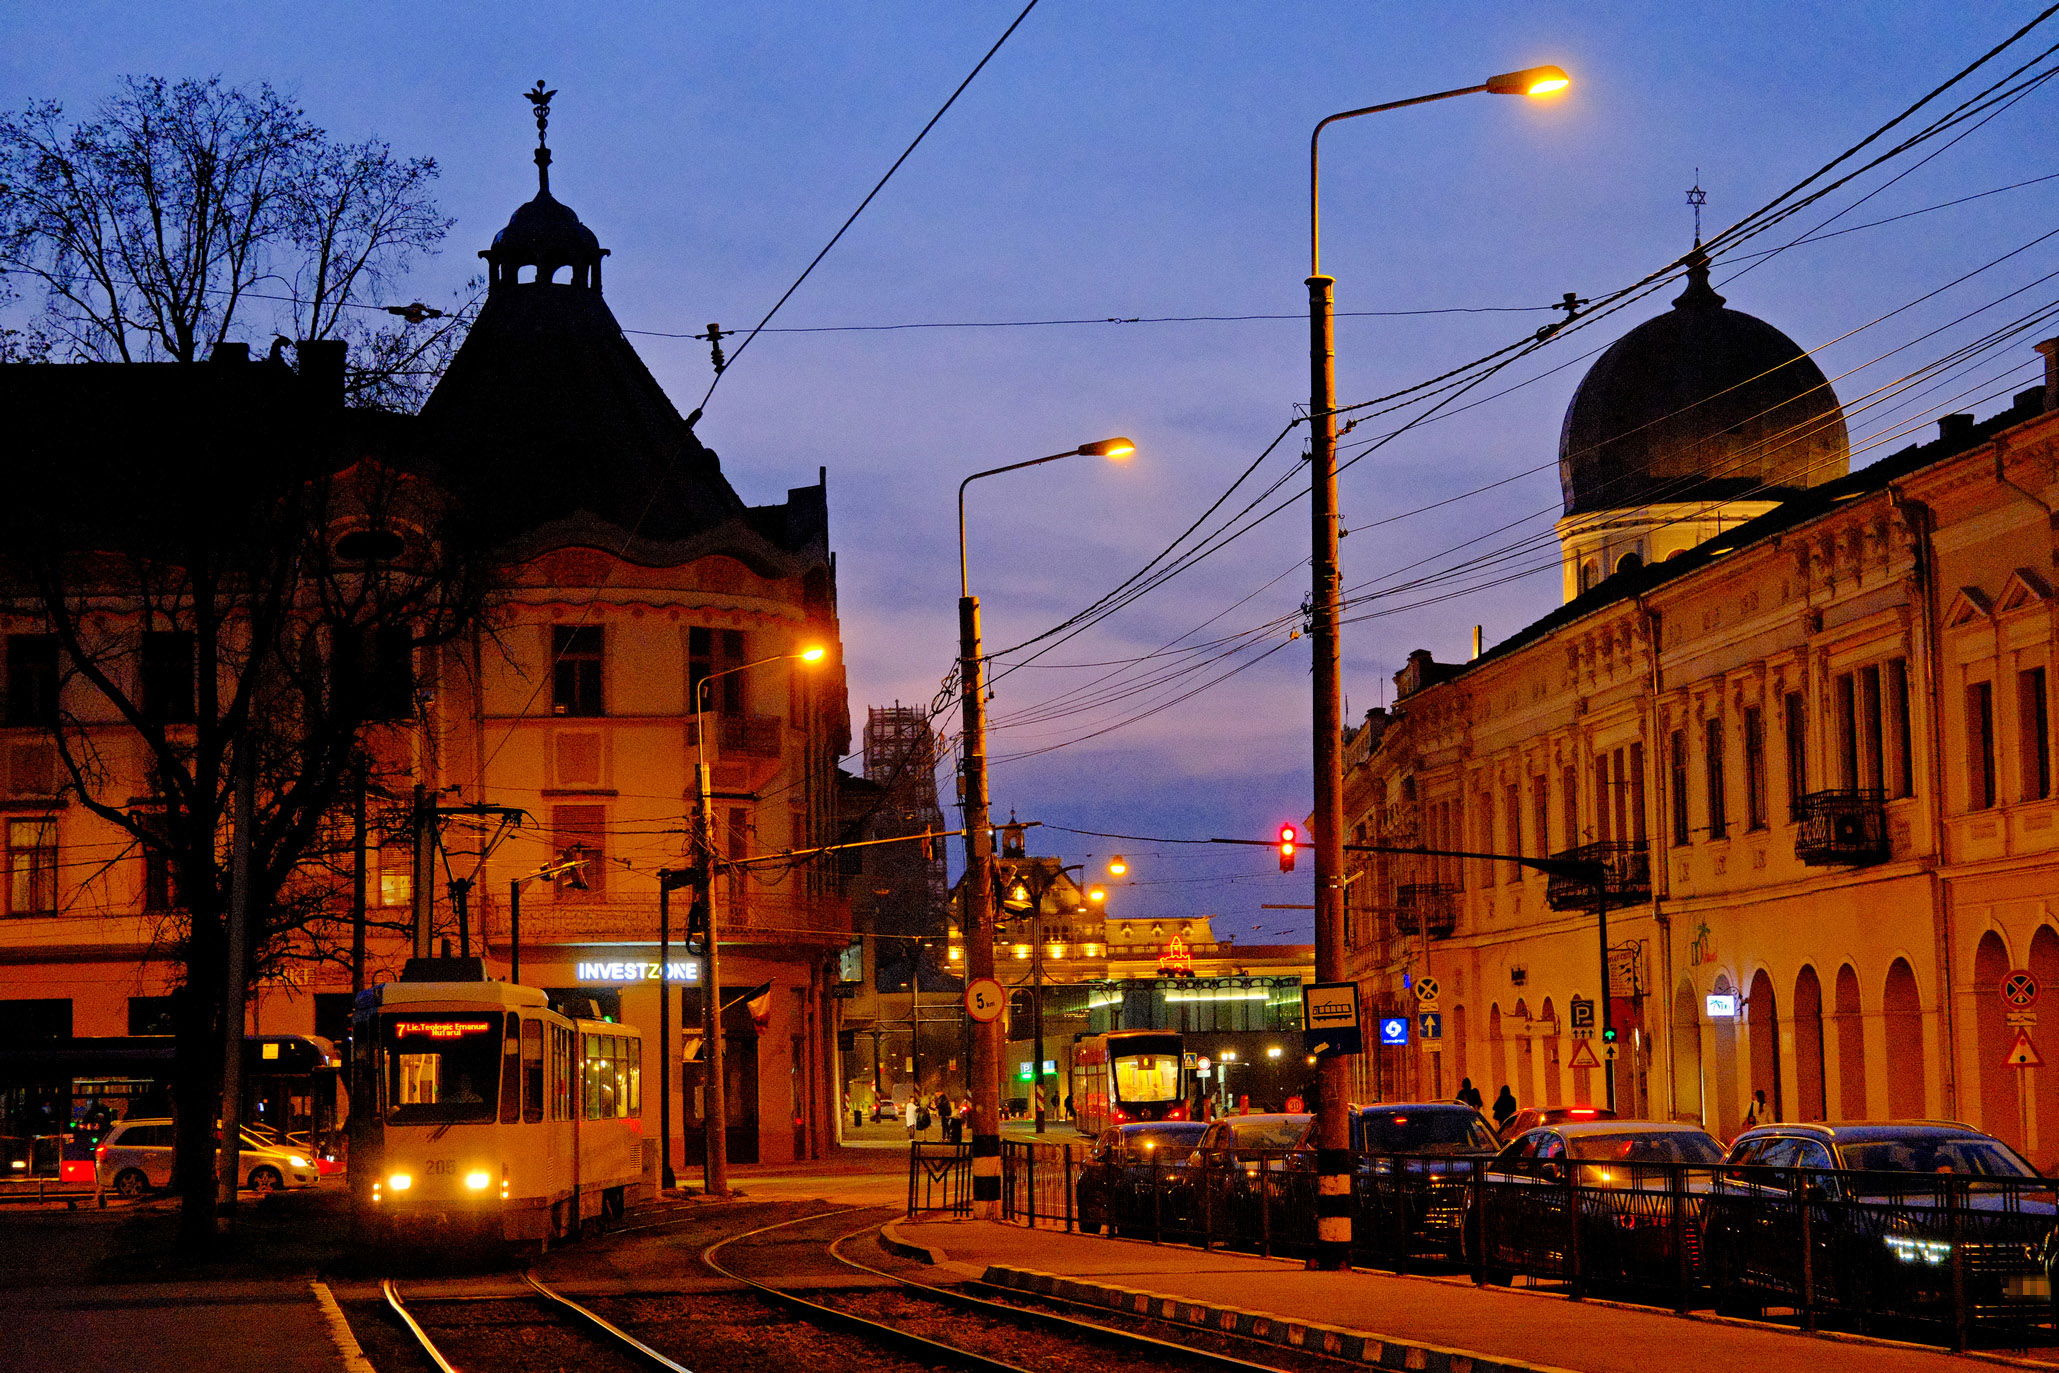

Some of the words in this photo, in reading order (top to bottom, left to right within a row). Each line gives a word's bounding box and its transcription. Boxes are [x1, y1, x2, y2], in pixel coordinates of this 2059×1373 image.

[976, 992, 985, 1009] 5
[396, 1023, 406, 1037] 7
[454, 1022, 489, 1031] Emanuel
